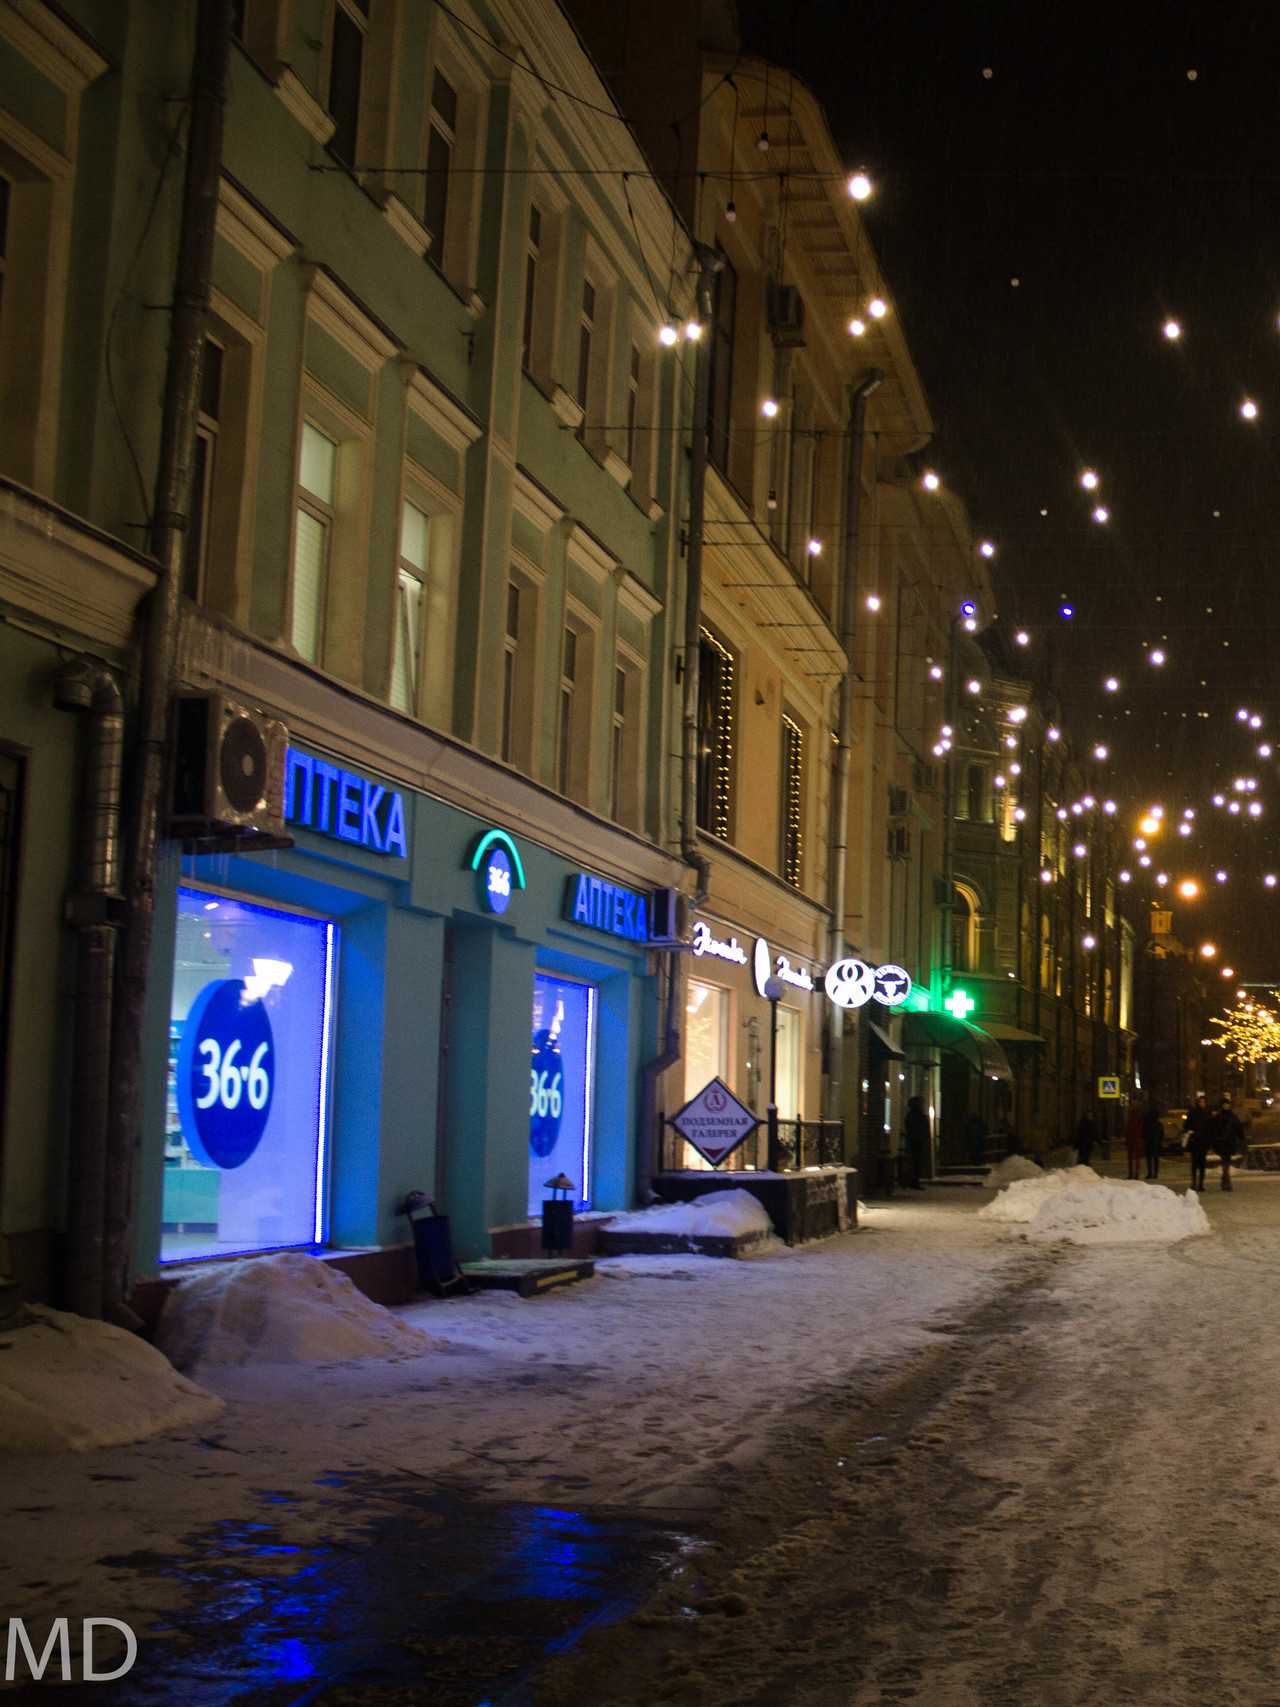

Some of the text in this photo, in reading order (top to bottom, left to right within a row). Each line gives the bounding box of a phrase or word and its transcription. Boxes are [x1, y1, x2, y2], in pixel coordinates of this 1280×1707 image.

[285, 747, 407, 858] ПТЕКА
[573, 872, 648, 943] АПТЕКА
[682, 1117, 749, 1127] ПОДЗЕМНАЯ
[692, 1129, 738, 1138] ГАЛЕРЕЯ
